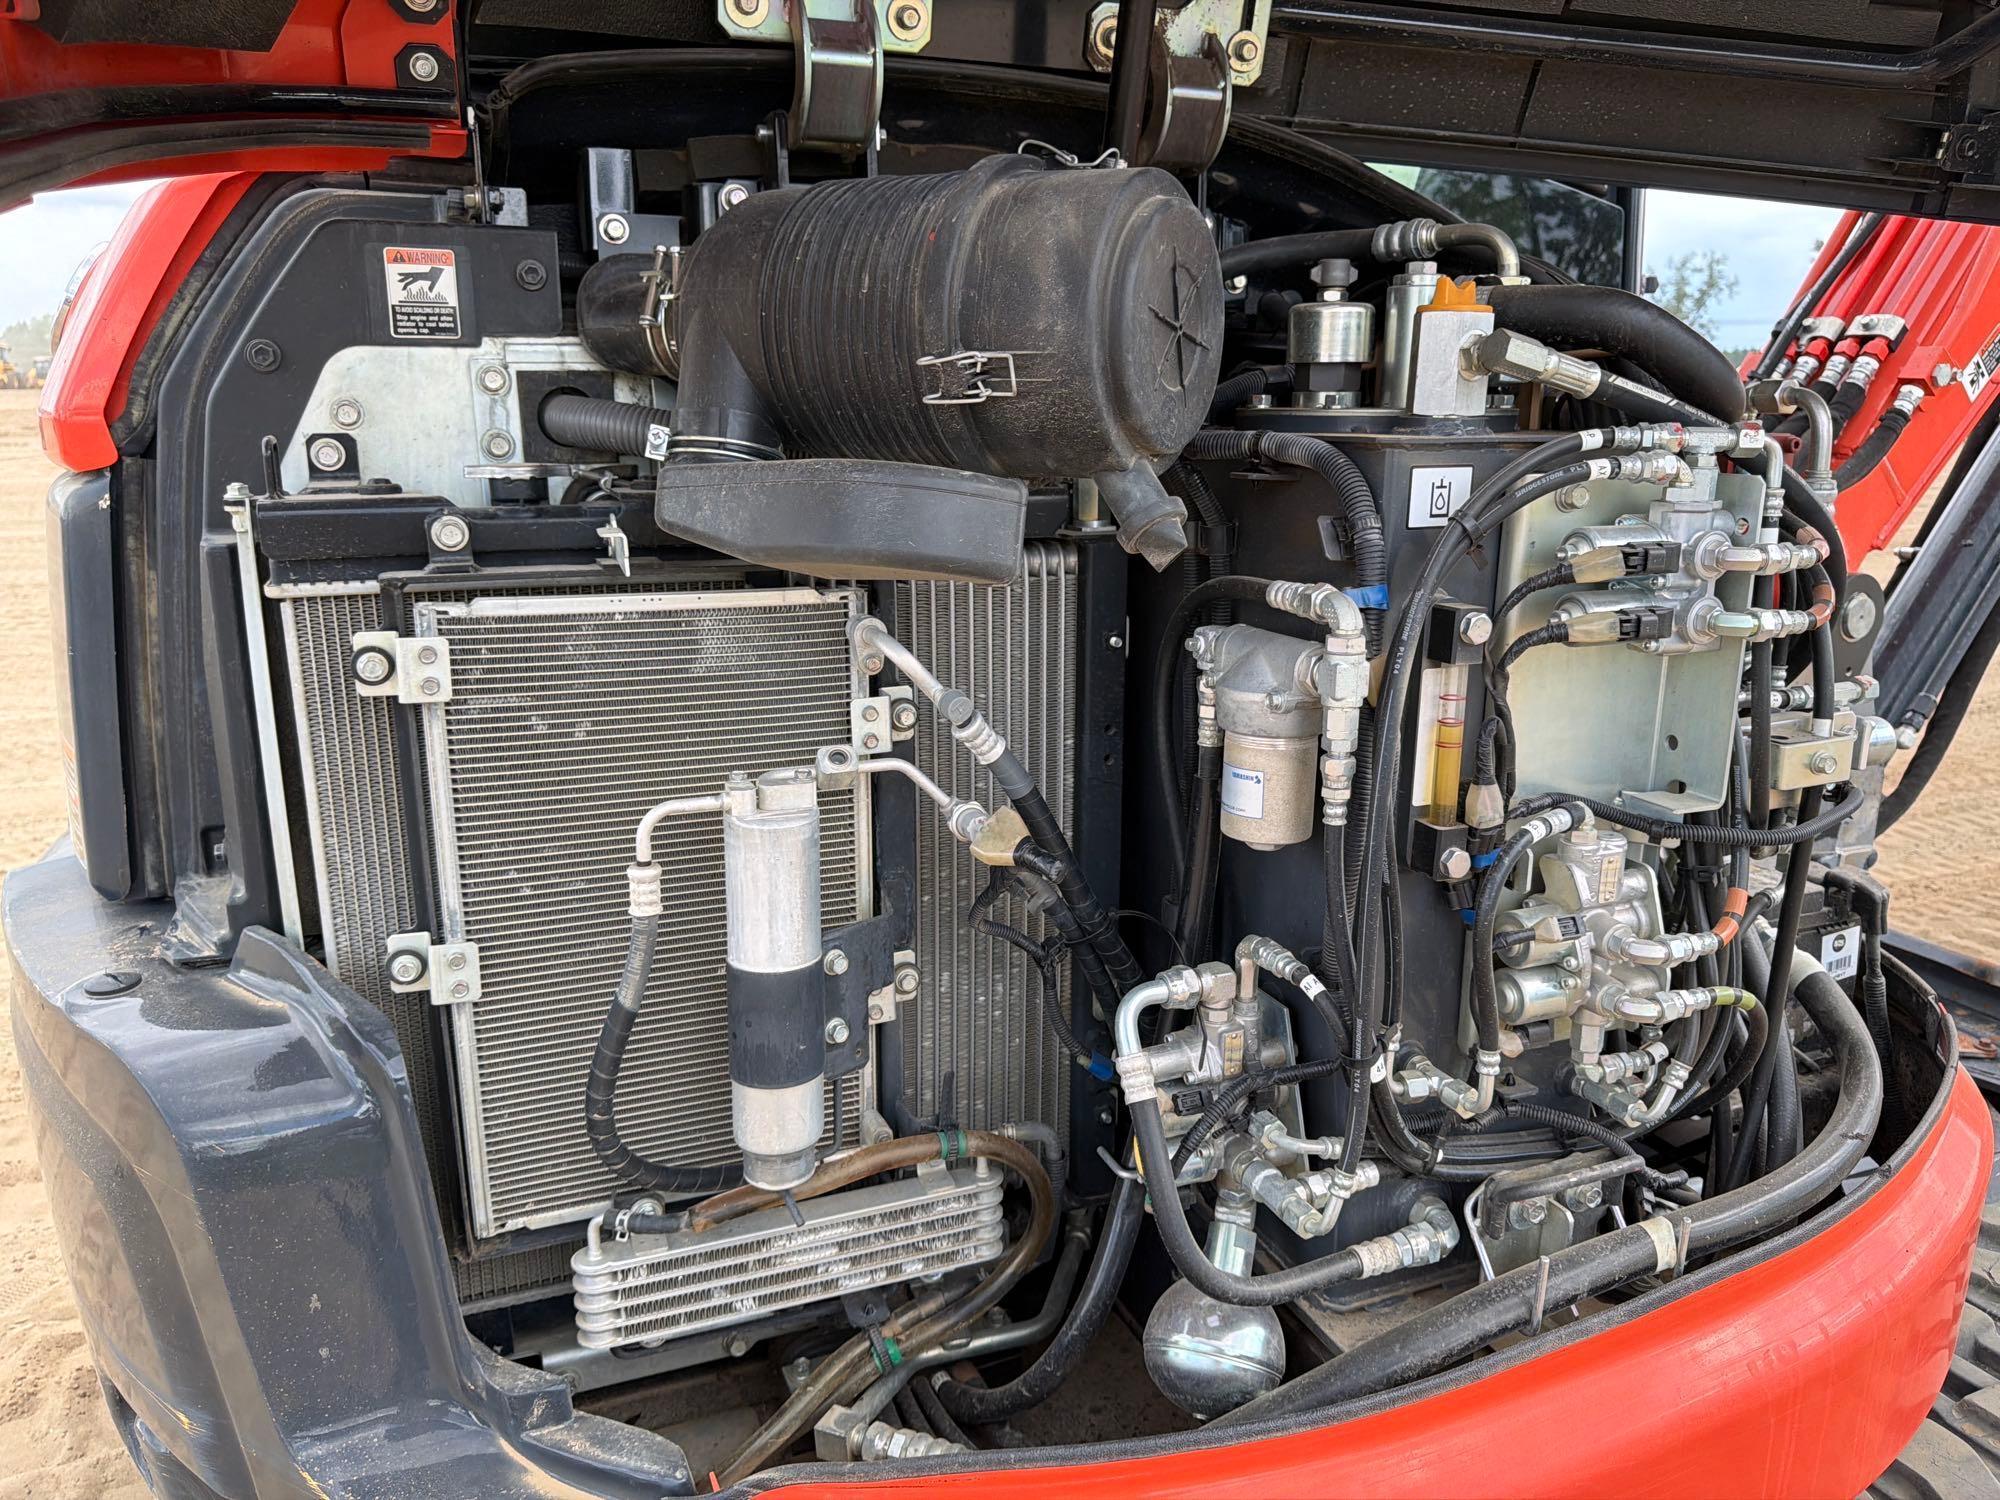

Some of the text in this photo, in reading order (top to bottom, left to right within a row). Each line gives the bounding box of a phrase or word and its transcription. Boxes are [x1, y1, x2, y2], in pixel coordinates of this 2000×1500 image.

[406, 252, 449, 264] WARNING
[1515, 470, 1564, 498] BRIDGESTONE
[1393, 588, 1424, 674] BRIDGESTONE PLT04
[1669, 1081, 1701, 1113] BRIDGESTONE
